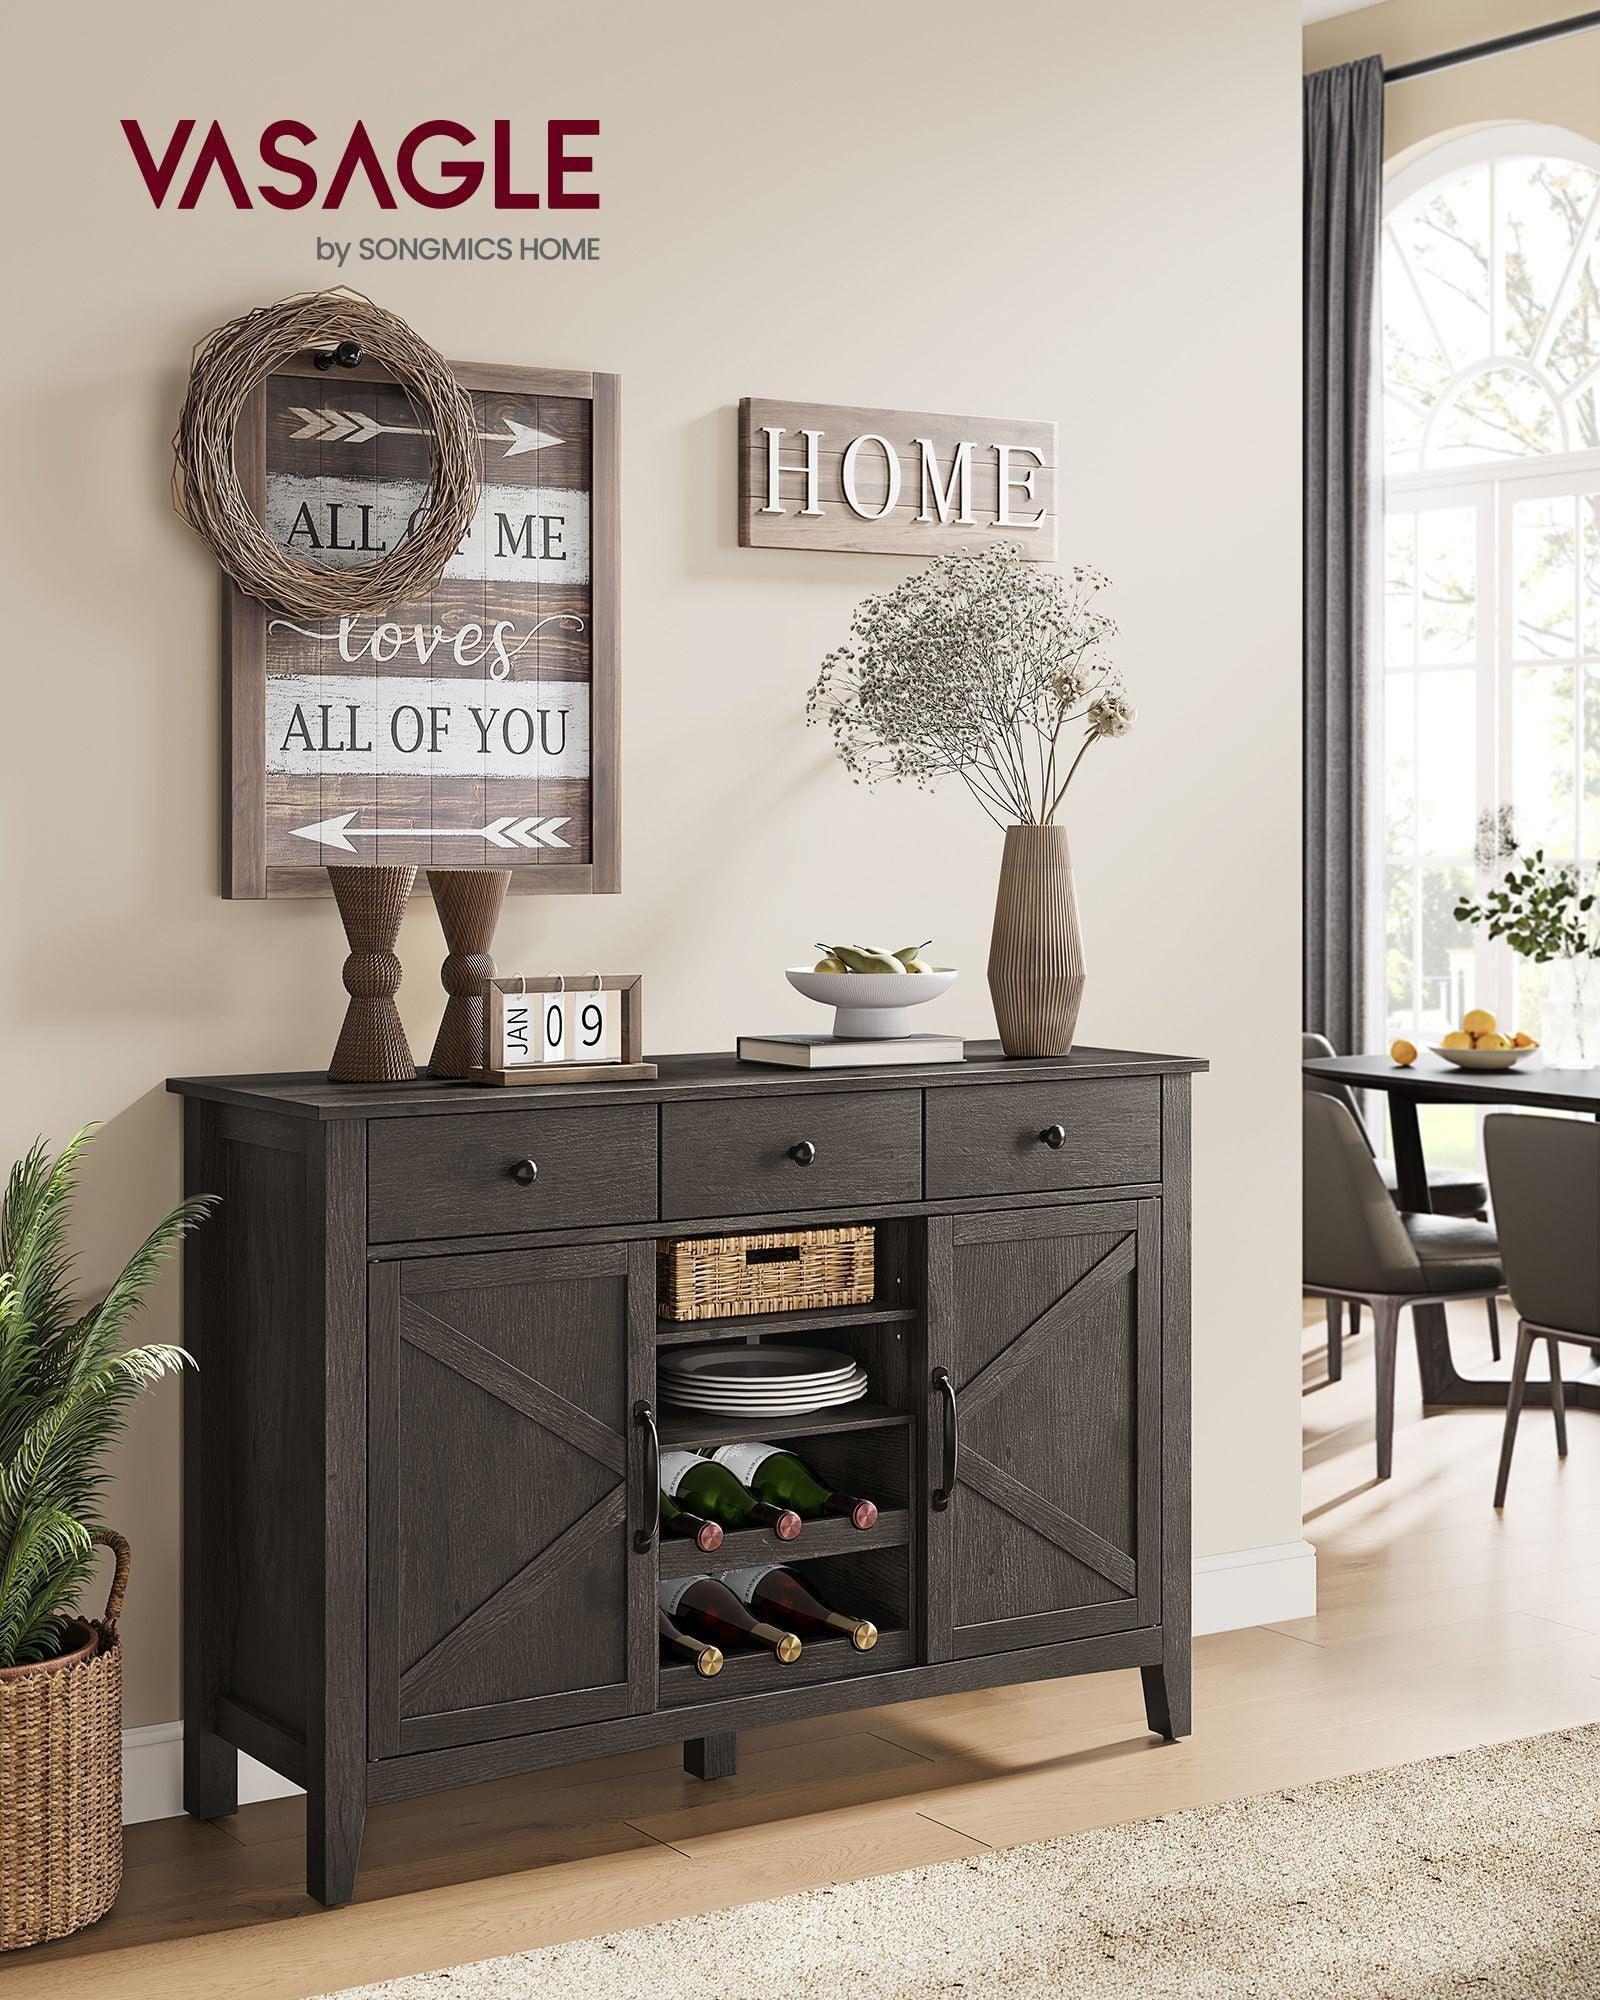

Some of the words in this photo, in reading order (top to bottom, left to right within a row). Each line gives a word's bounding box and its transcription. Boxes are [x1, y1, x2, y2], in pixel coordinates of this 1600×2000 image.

[757, 427, 1047, 529] HOME
[284, 501, 386, 551] ALL
[494, 512, 567, 561] ME
[268, 603, 584, 681] loves
[279, 703, 372, 752] ALL
[390, 705, 451, 753] OF
[468, 707, 569, 756] YOU
[507, 1008, 529, 1055] JAN
